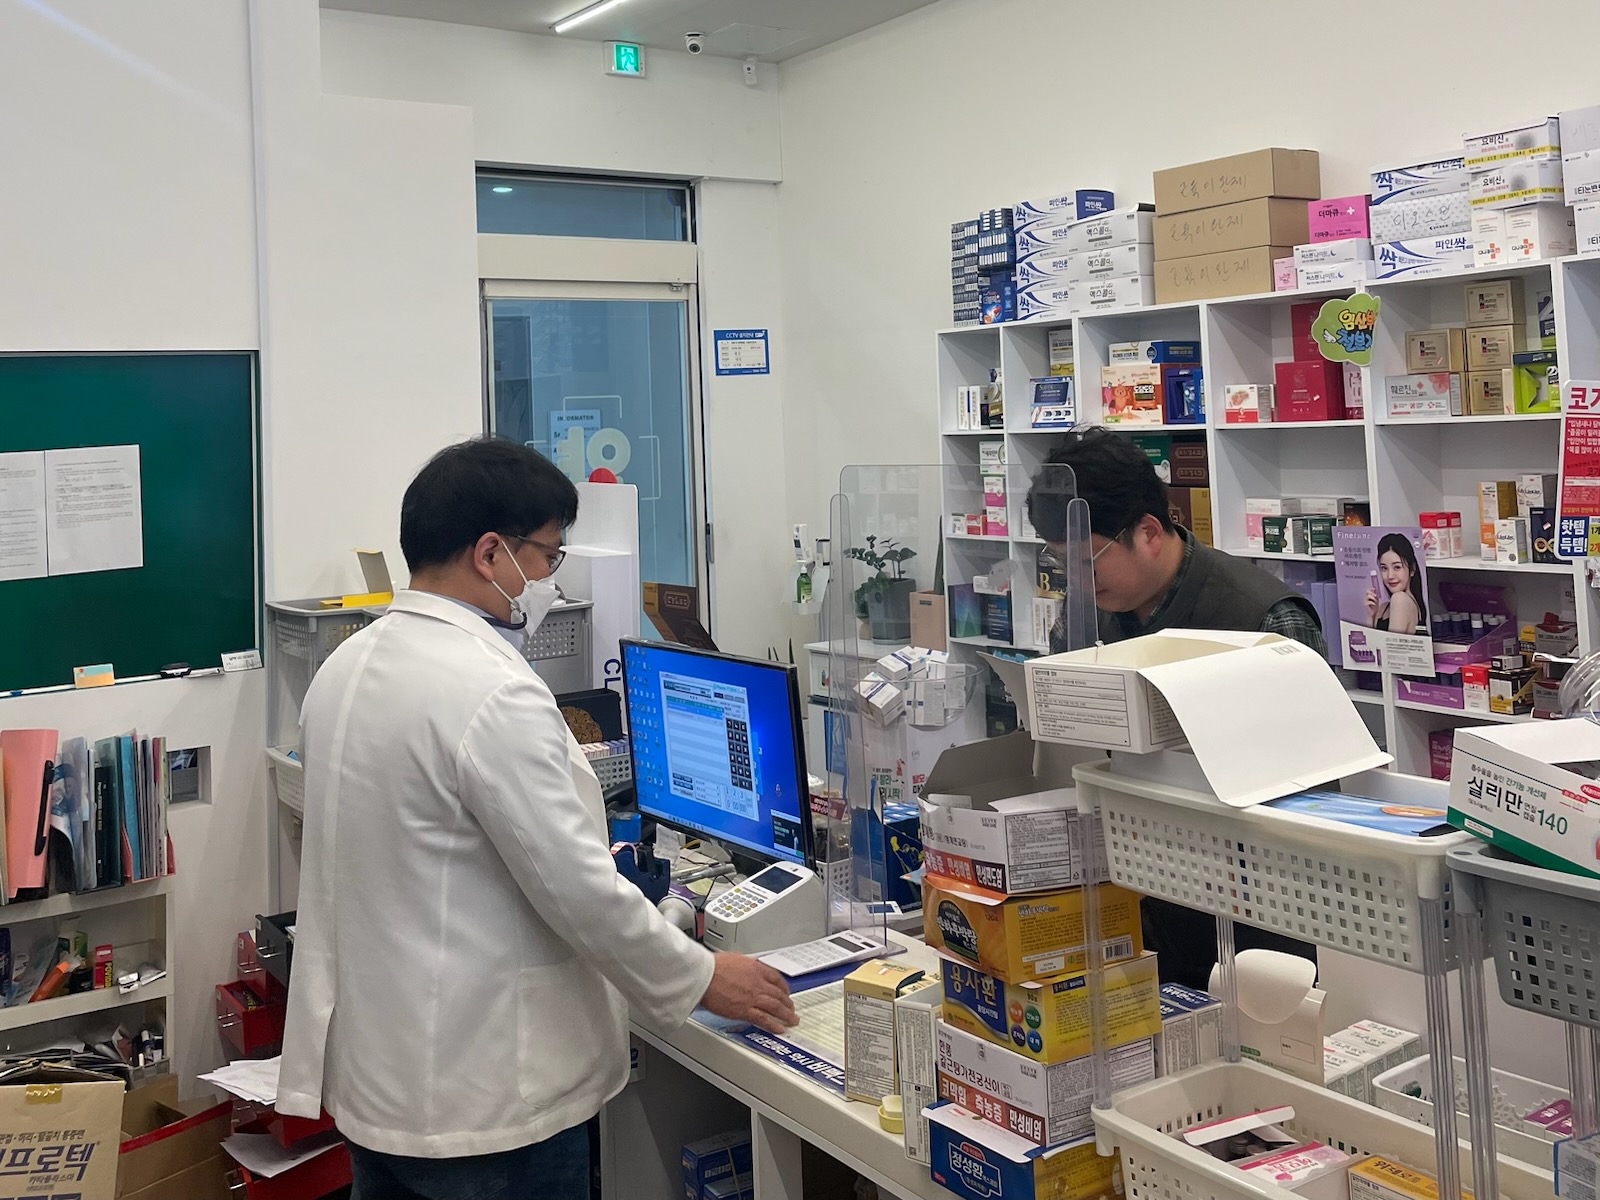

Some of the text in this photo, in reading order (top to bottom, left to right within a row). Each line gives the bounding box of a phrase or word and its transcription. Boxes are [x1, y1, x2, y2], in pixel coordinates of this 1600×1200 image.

[1481, 134, 1504, 146] 요비신
[1482, 175, 1502, 187] 요비신
[1435, 237, 1467, 251] 파인싹
[1379, 246, 1398, 270] 싹
[1337, 531, 1371, 541] Finetune
[1562, 520, 1585, 536] 핫템
[1560, 537, 1588, 553] 득템!
[1467, 776, 1523, 816] 실리만
[1506, 777, 1525, 792] 간기능
[1526, 784, 1547, 801] 개선제
[1537, 808, 1568, 836] 140
[950, 963, 998, 1007] 용사환
[941, 1077, 967, 1106] 코막힘
[975, 1093, 1002, 1123] 축농증
[1009, 1109, 1042, 1142] 만성비염
[0, 1142, 96, 1182] 프로텍
